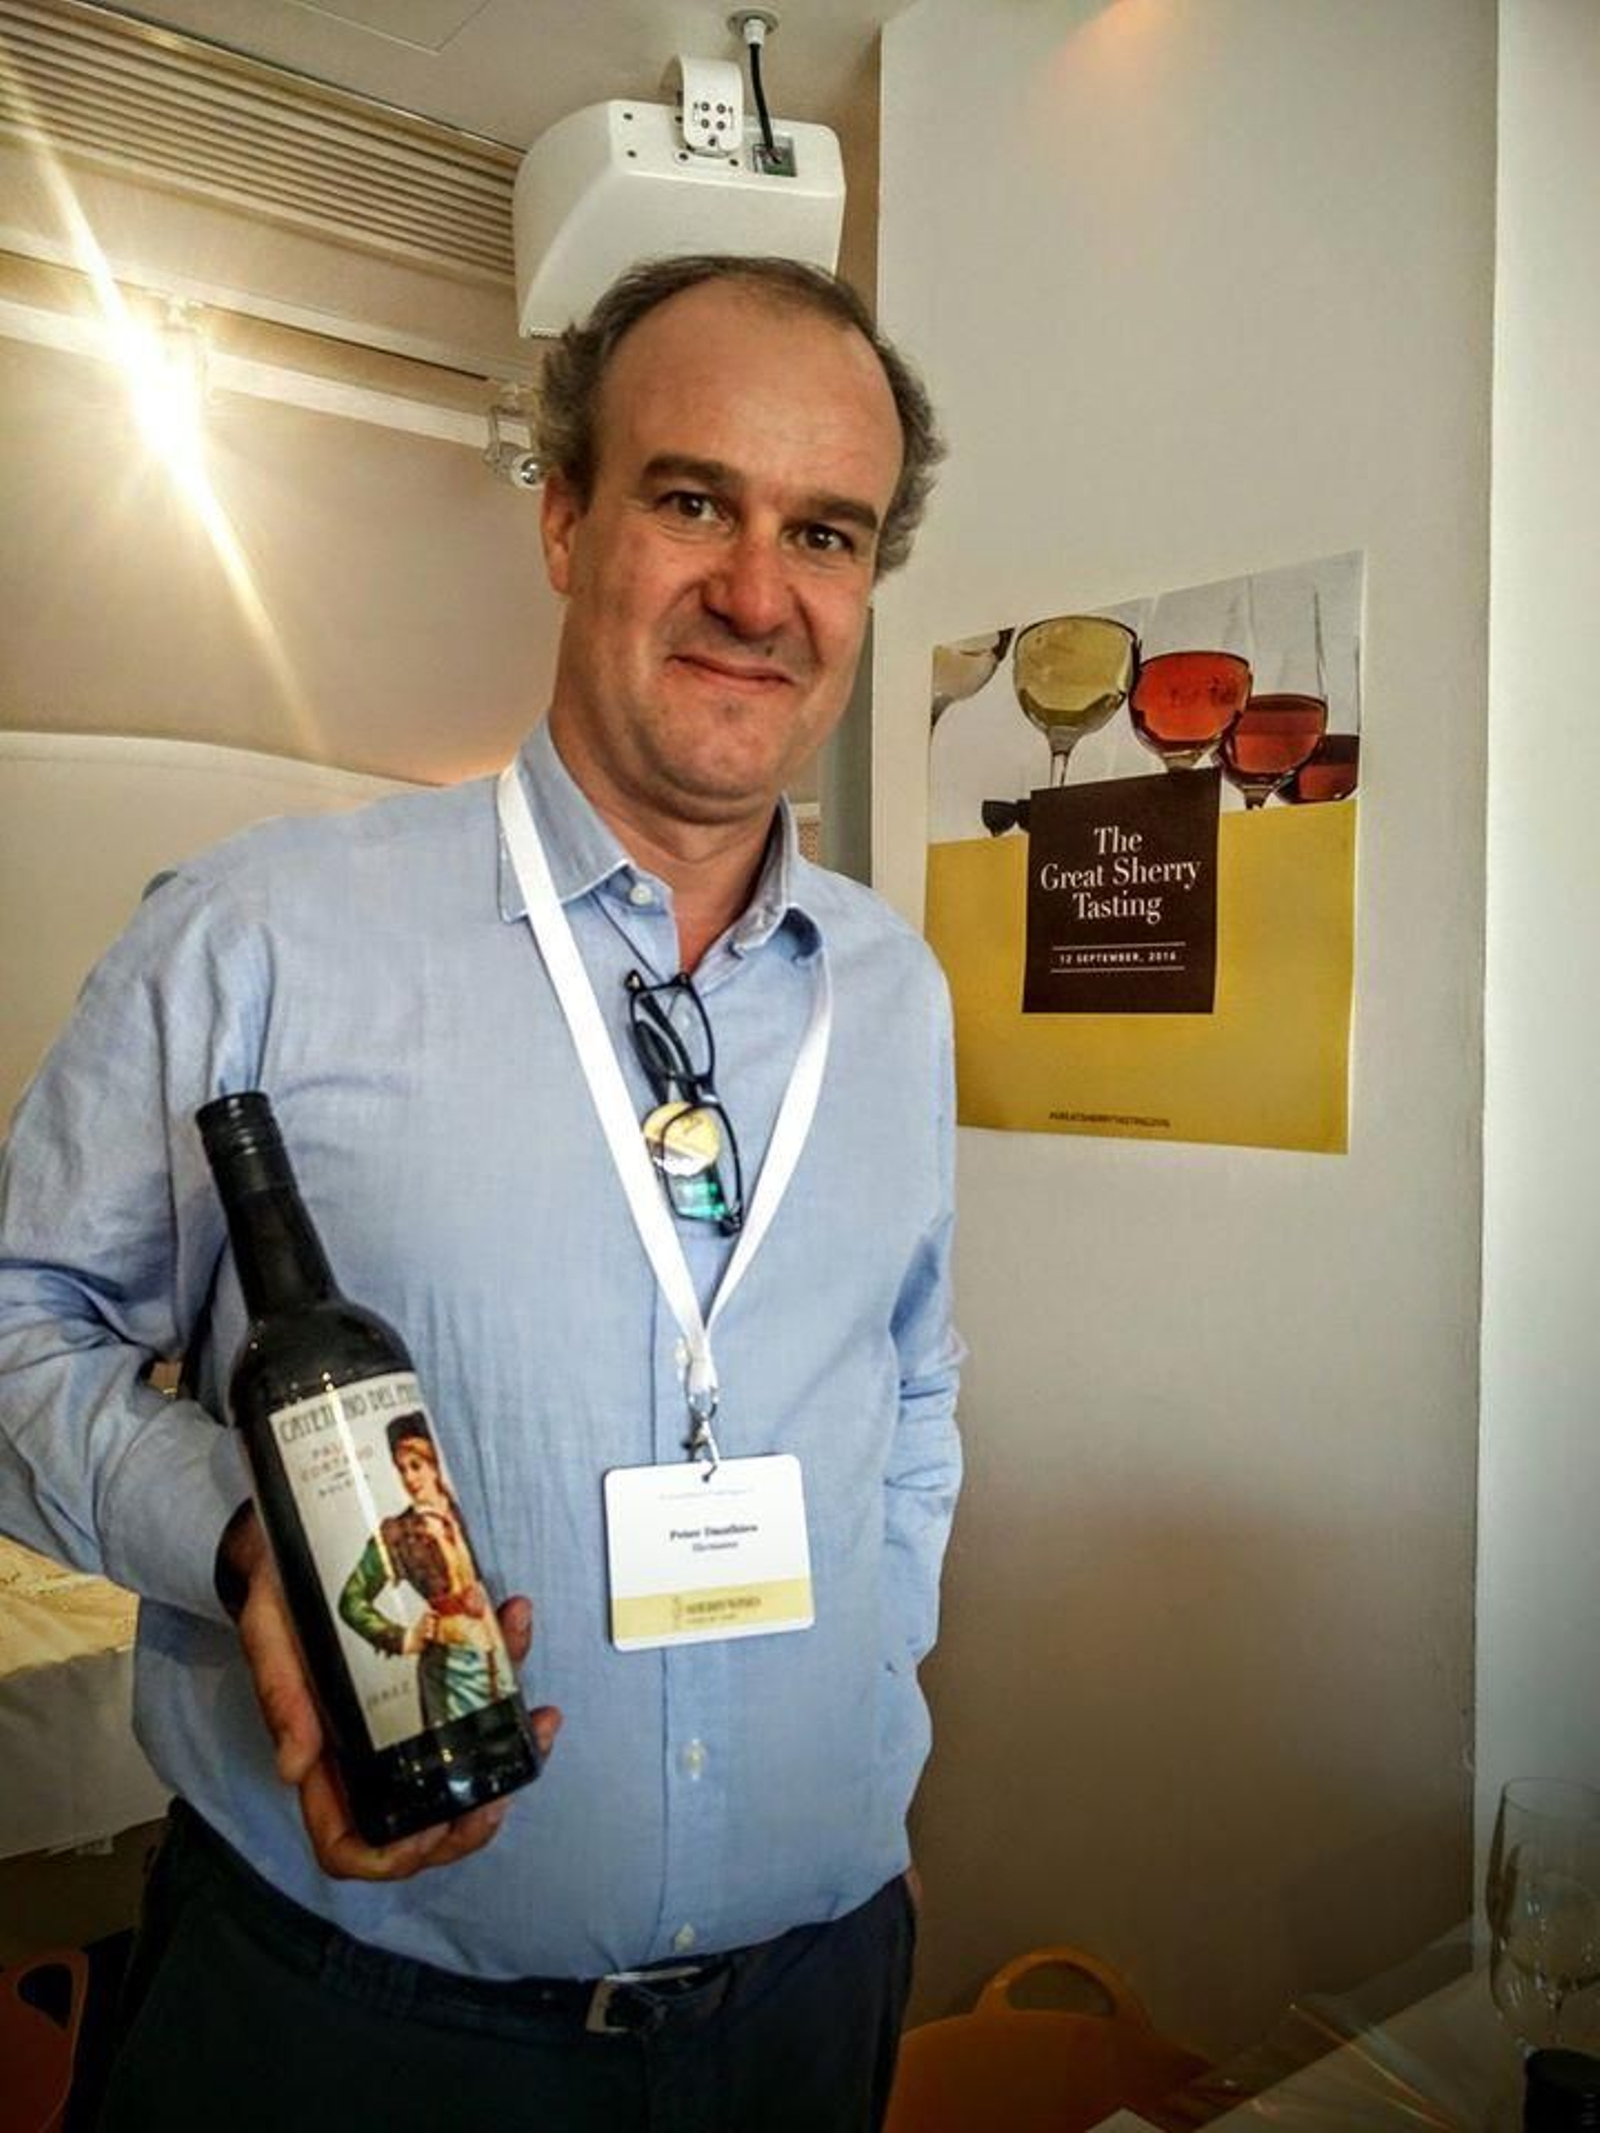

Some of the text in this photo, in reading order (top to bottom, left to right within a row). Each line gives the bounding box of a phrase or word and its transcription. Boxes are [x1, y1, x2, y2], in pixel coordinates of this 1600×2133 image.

[1093, 825, 1143, 855] The
[1040, 856, 1202, 891] Great Sherry
[1072, 889, 1164, 925] Tasting
[1060, 951, 1177, 965] 12 SEPTEMBER, 2016
